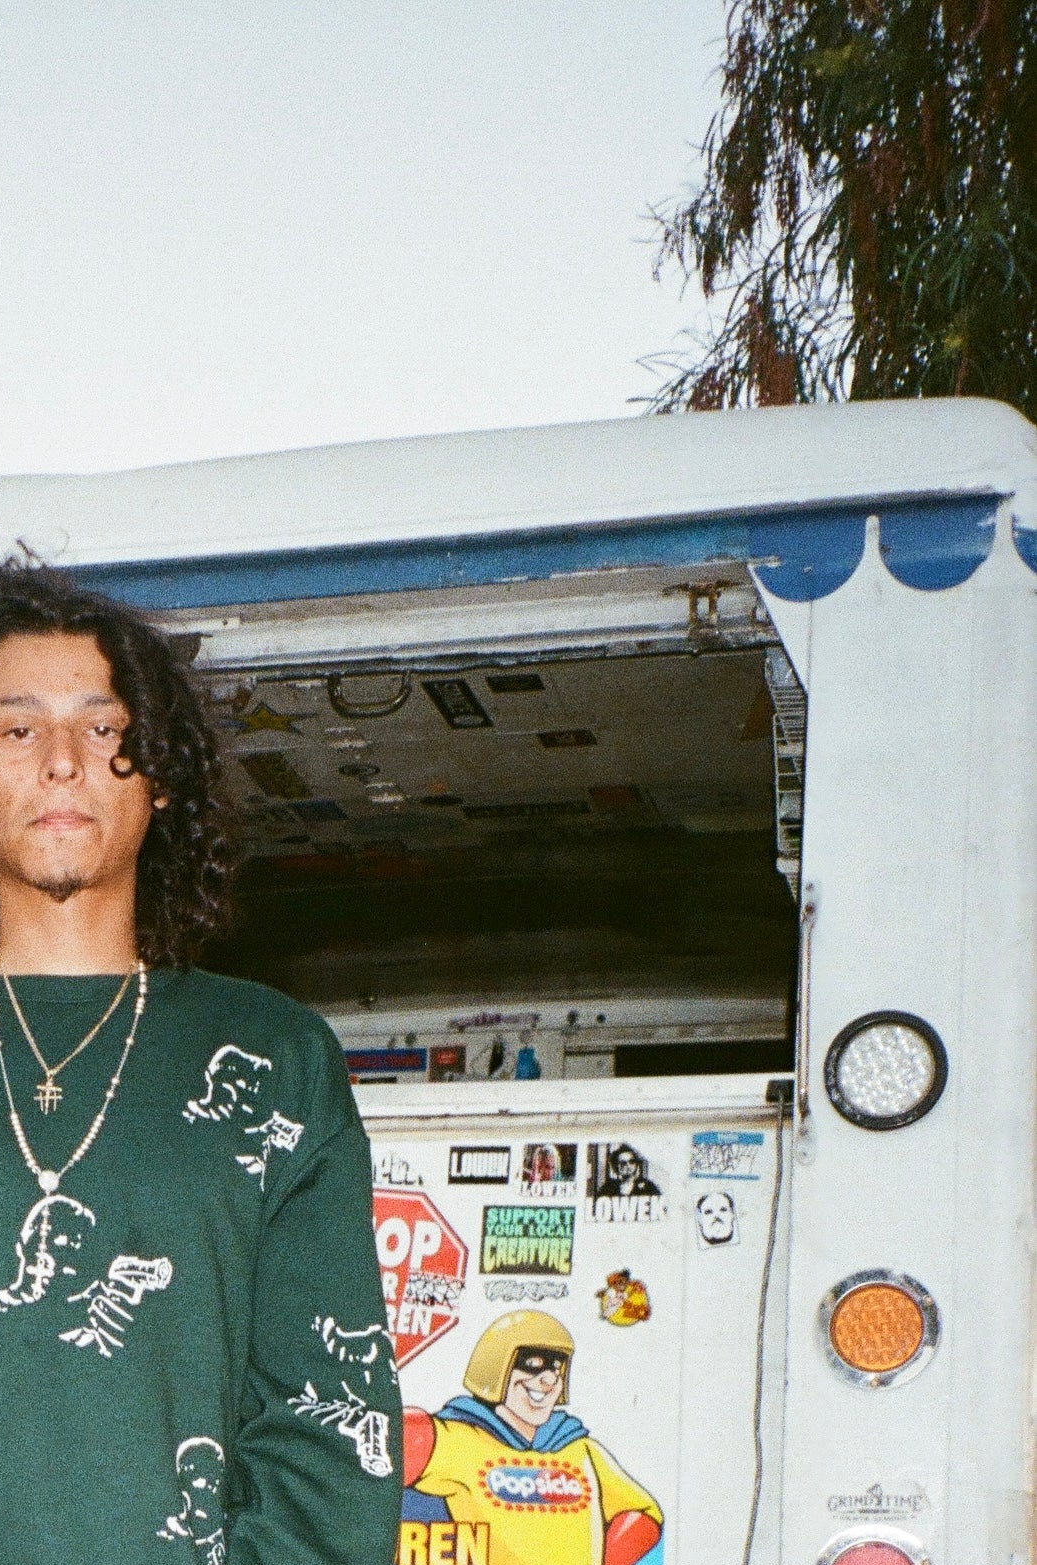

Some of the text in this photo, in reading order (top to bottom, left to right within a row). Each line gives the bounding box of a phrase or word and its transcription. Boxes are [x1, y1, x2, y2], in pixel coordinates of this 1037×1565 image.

[486, 1207, 574, 1225] SUPPORT
[486, 1223, 573, 1237] YOUR LOCAL
[373, 1215, 442, 1274] OP
[483, 1236, 572, 1274] CREATURE
[489, 1470, 582, 1498] Popsicle
